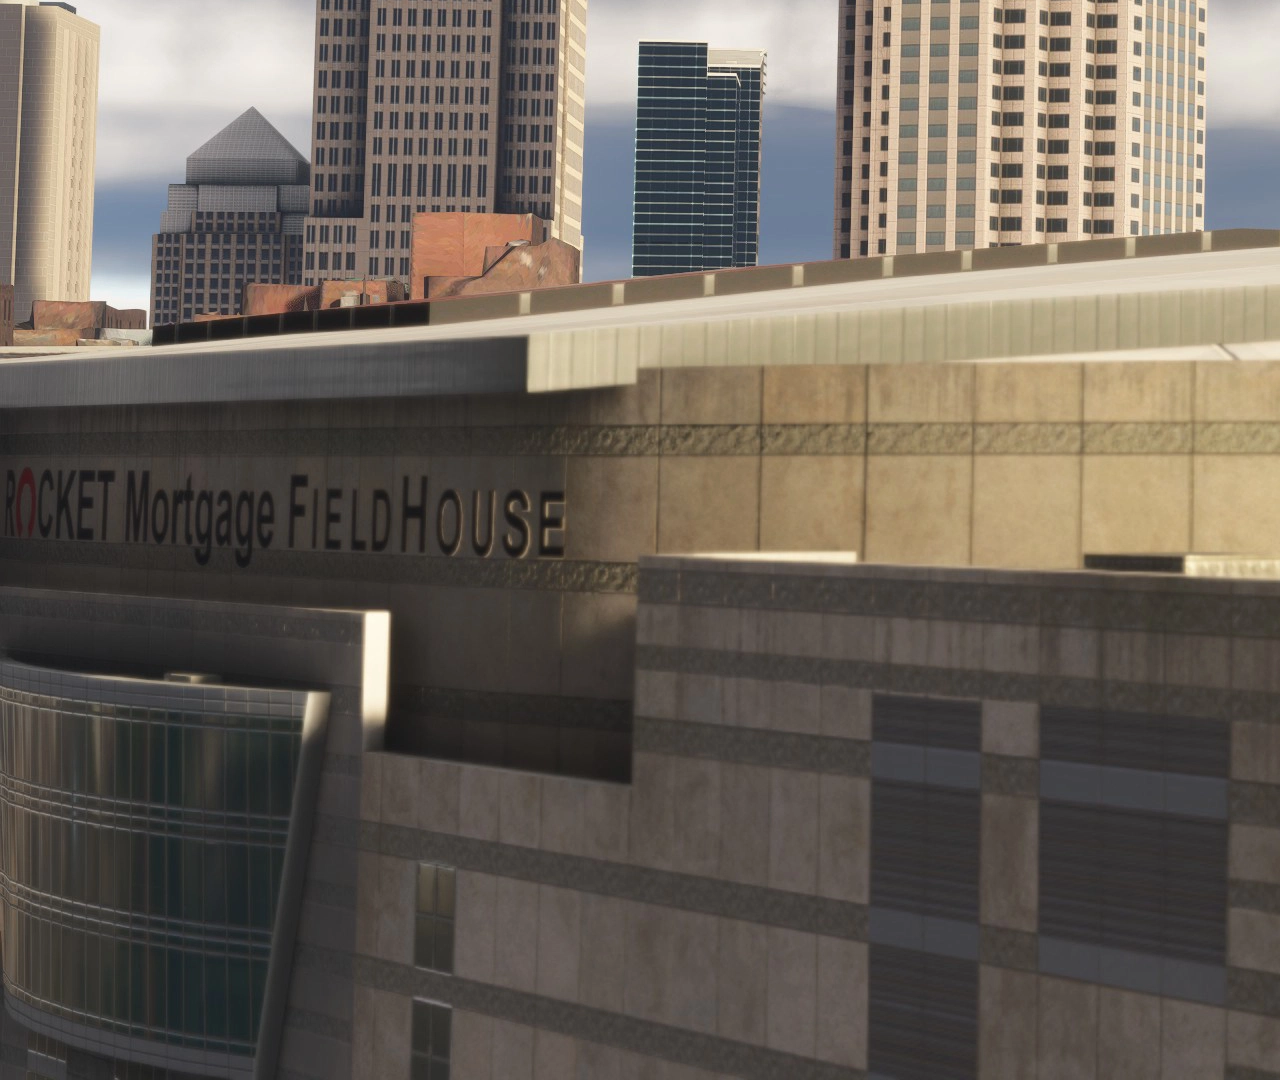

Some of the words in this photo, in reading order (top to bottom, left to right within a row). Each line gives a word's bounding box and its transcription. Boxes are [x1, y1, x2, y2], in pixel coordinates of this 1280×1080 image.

[5, 466, 116, 541] ROCKET
[124, 469, 275, 568] Mortgage
[288, 473, 567, 559] FIELDHOUSE
